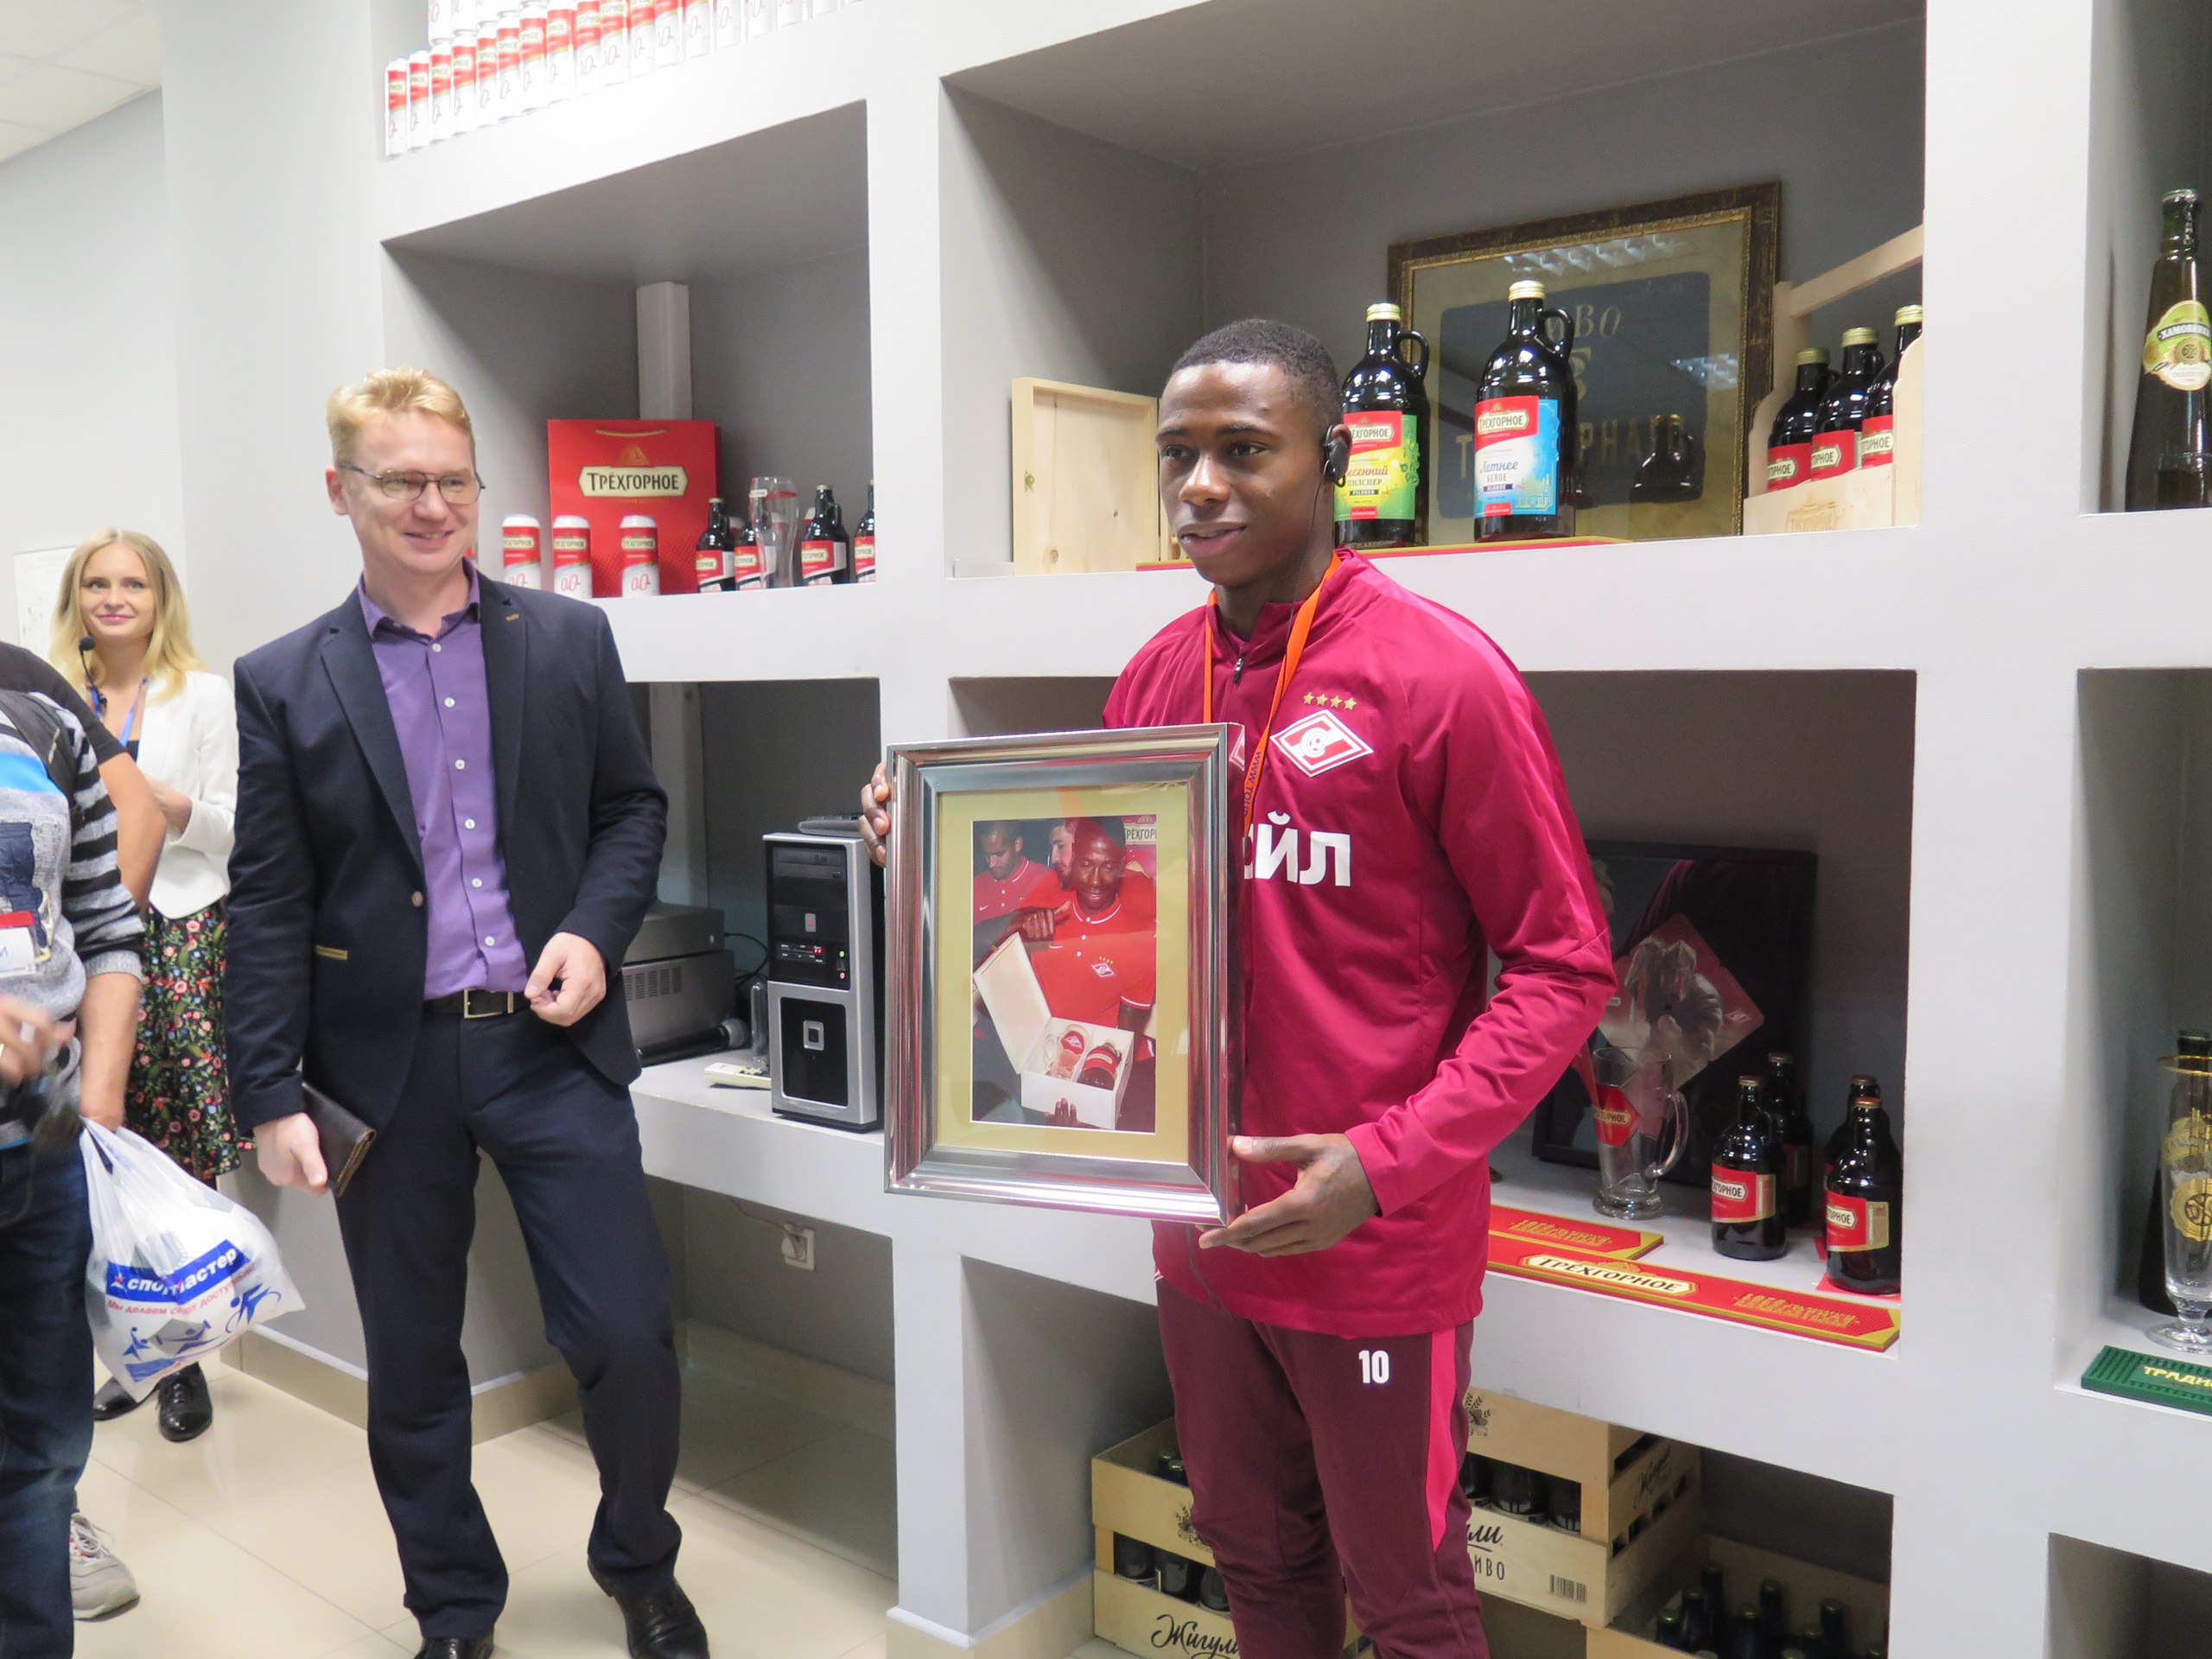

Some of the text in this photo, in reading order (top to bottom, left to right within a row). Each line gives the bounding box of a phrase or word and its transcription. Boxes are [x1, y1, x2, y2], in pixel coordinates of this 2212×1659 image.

[587, 472, 679, 492] ТРЁХГОРНОЕ
[1358, 1350, 1389, 1384] 10
[2143, 1366, 2212, 1388] ТРАДИ
[1474, 1554, 1506, 1581] ИВО
